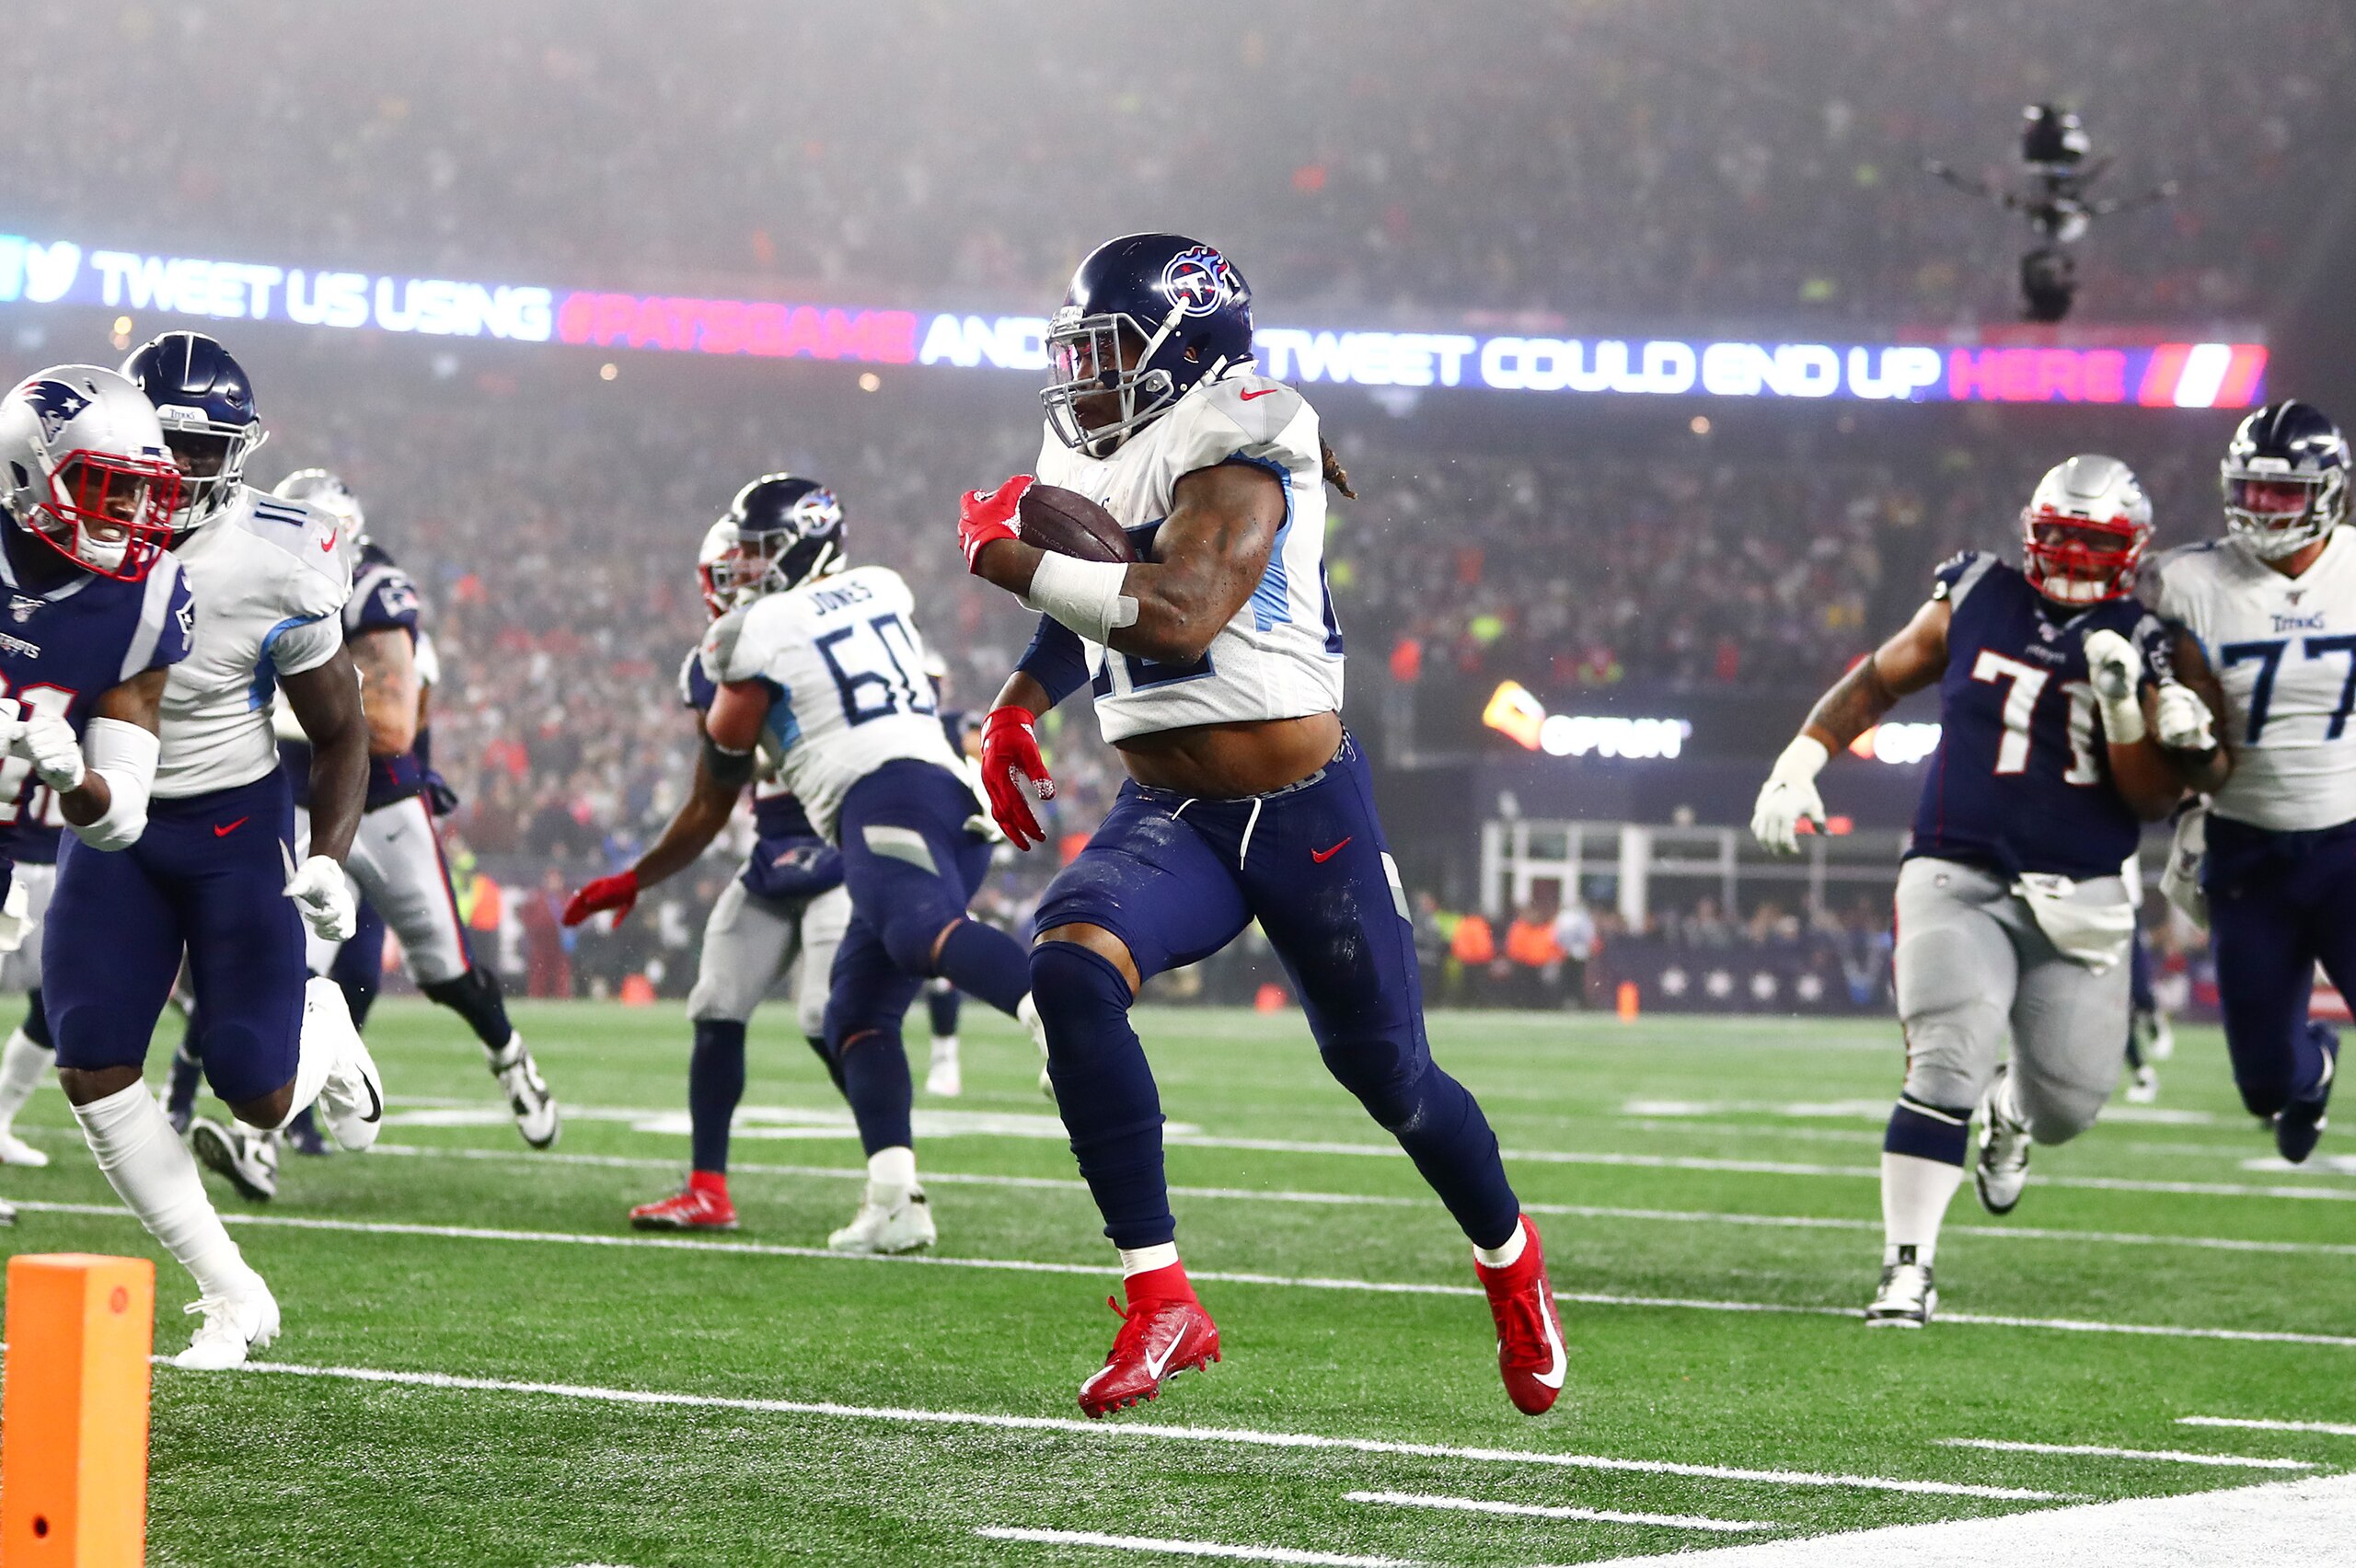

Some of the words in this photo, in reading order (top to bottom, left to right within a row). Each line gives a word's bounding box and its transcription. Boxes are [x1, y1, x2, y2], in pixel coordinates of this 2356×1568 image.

[91, 250, 282, 318] TWEET
[286, 269, 368, 328] US
[375, 277, 552, 341] USING
[560, 292, 917, 364] #PATSGAME
[919, 313, 1051, 370] AND
[1253, 329, 1476, 386] TWEET
[1481, 337, 1696, 394] COULD
[1703, 342, 1840, 398] END
[1848, 346, 1941, 399] UP
[1948, 348, 2127, 402] HERE
[254, 502, 307, 527] 11
[807, 581, 873, 616] JONES
[1969, 648, 2102, 786] 71
[2220, 633, 2356, 744] 77
